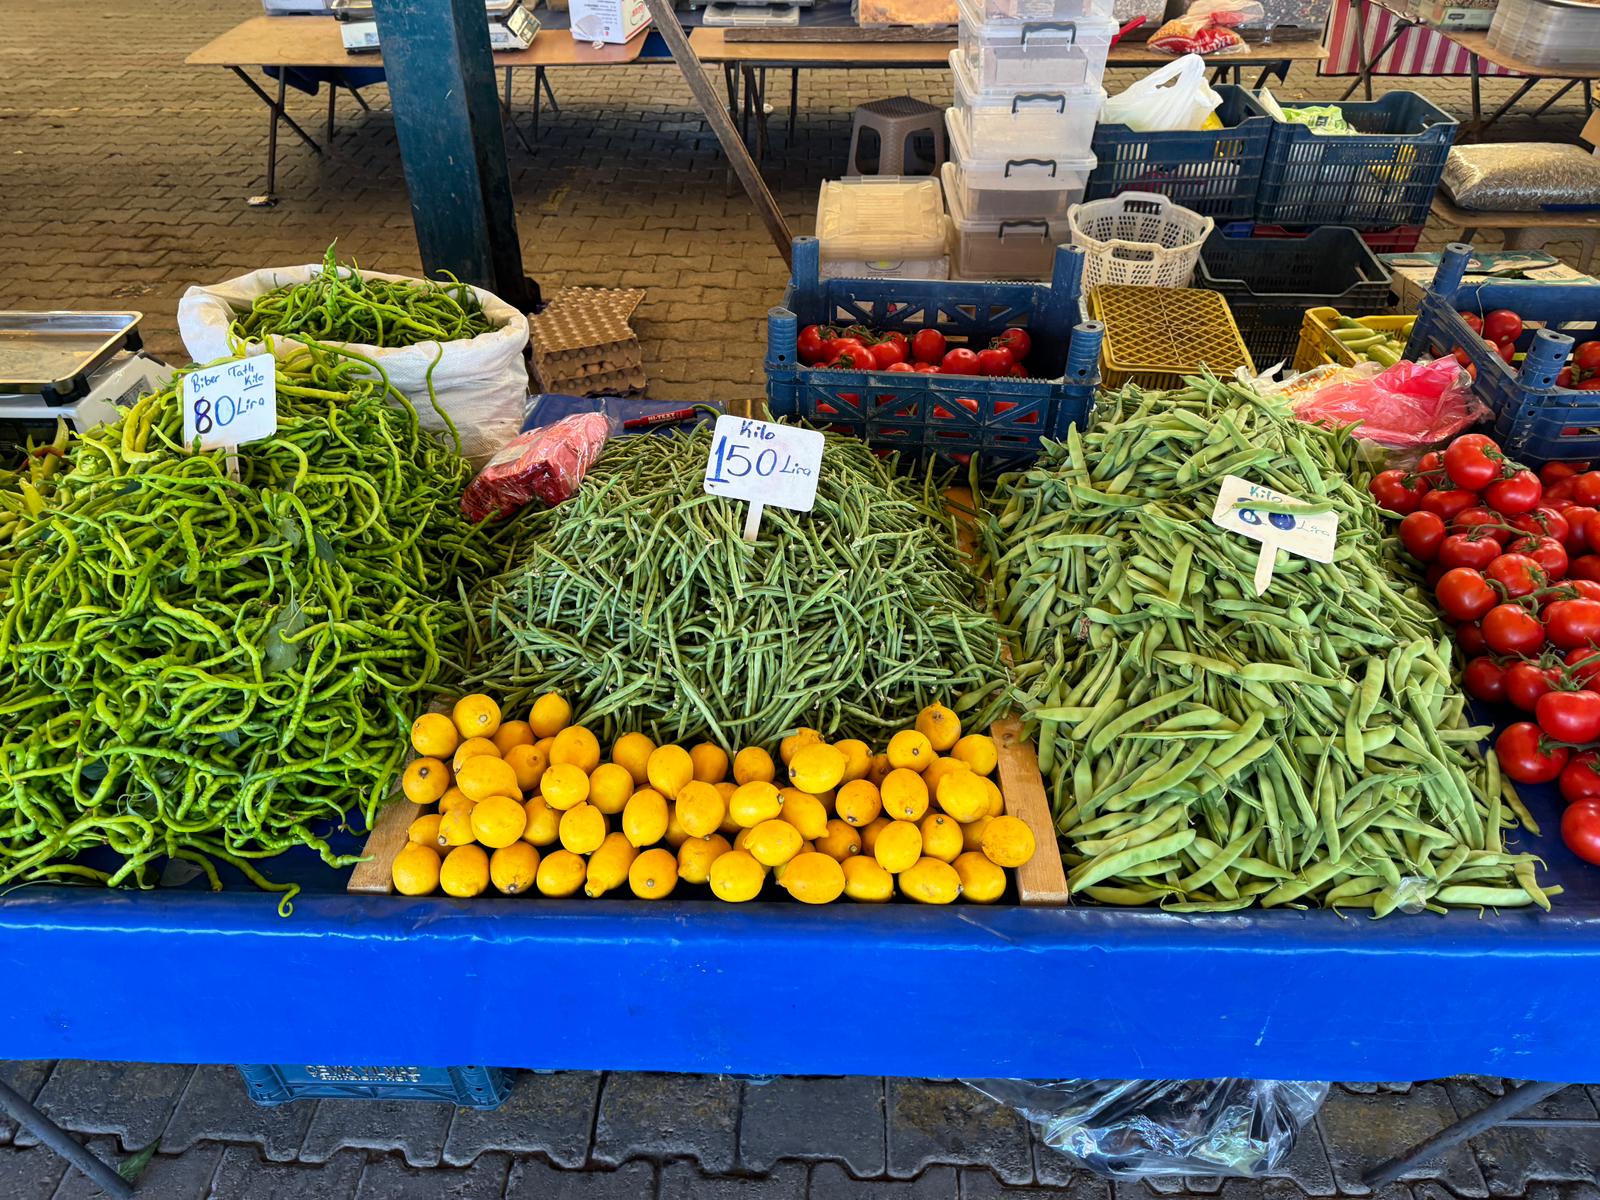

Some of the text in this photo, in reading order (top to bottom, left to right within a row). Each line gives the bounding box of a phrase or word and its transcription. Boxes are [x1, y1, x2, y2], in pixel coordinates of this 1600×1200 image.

[191, 373, 220, 393] Biber
[194, 395, 265, 434] 80 Lira
[739, 420, 776, 440] Kilo
[706, 435, 812, 483] 150 Lira
[1249, 486, 1283, 503] Kilo
